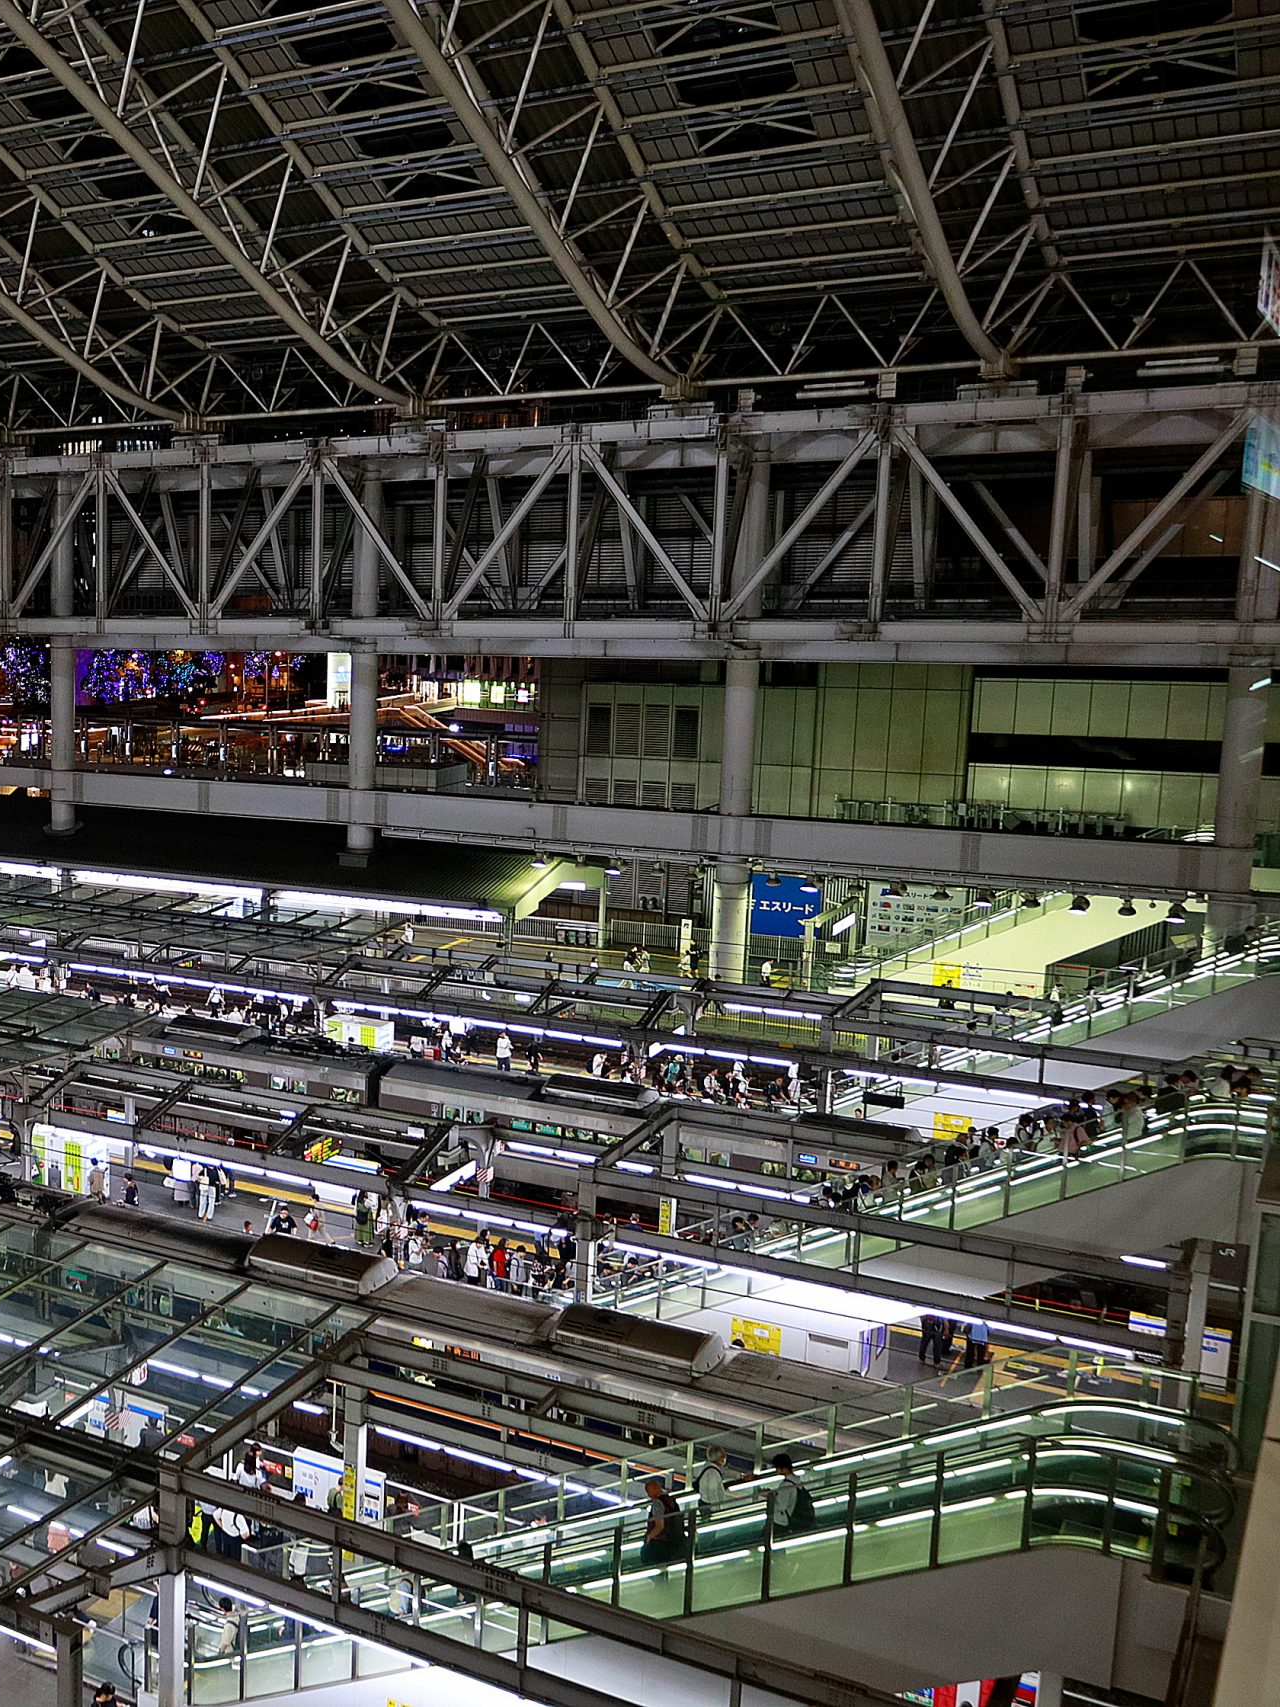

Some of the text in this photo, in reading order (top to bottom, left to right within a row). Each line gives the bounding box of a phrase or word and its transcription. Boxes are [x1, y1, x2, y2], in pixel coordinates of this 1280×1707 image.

[760, 900, 814, 914] エスリード
[1219, 1248, 1236, 1258] JR
